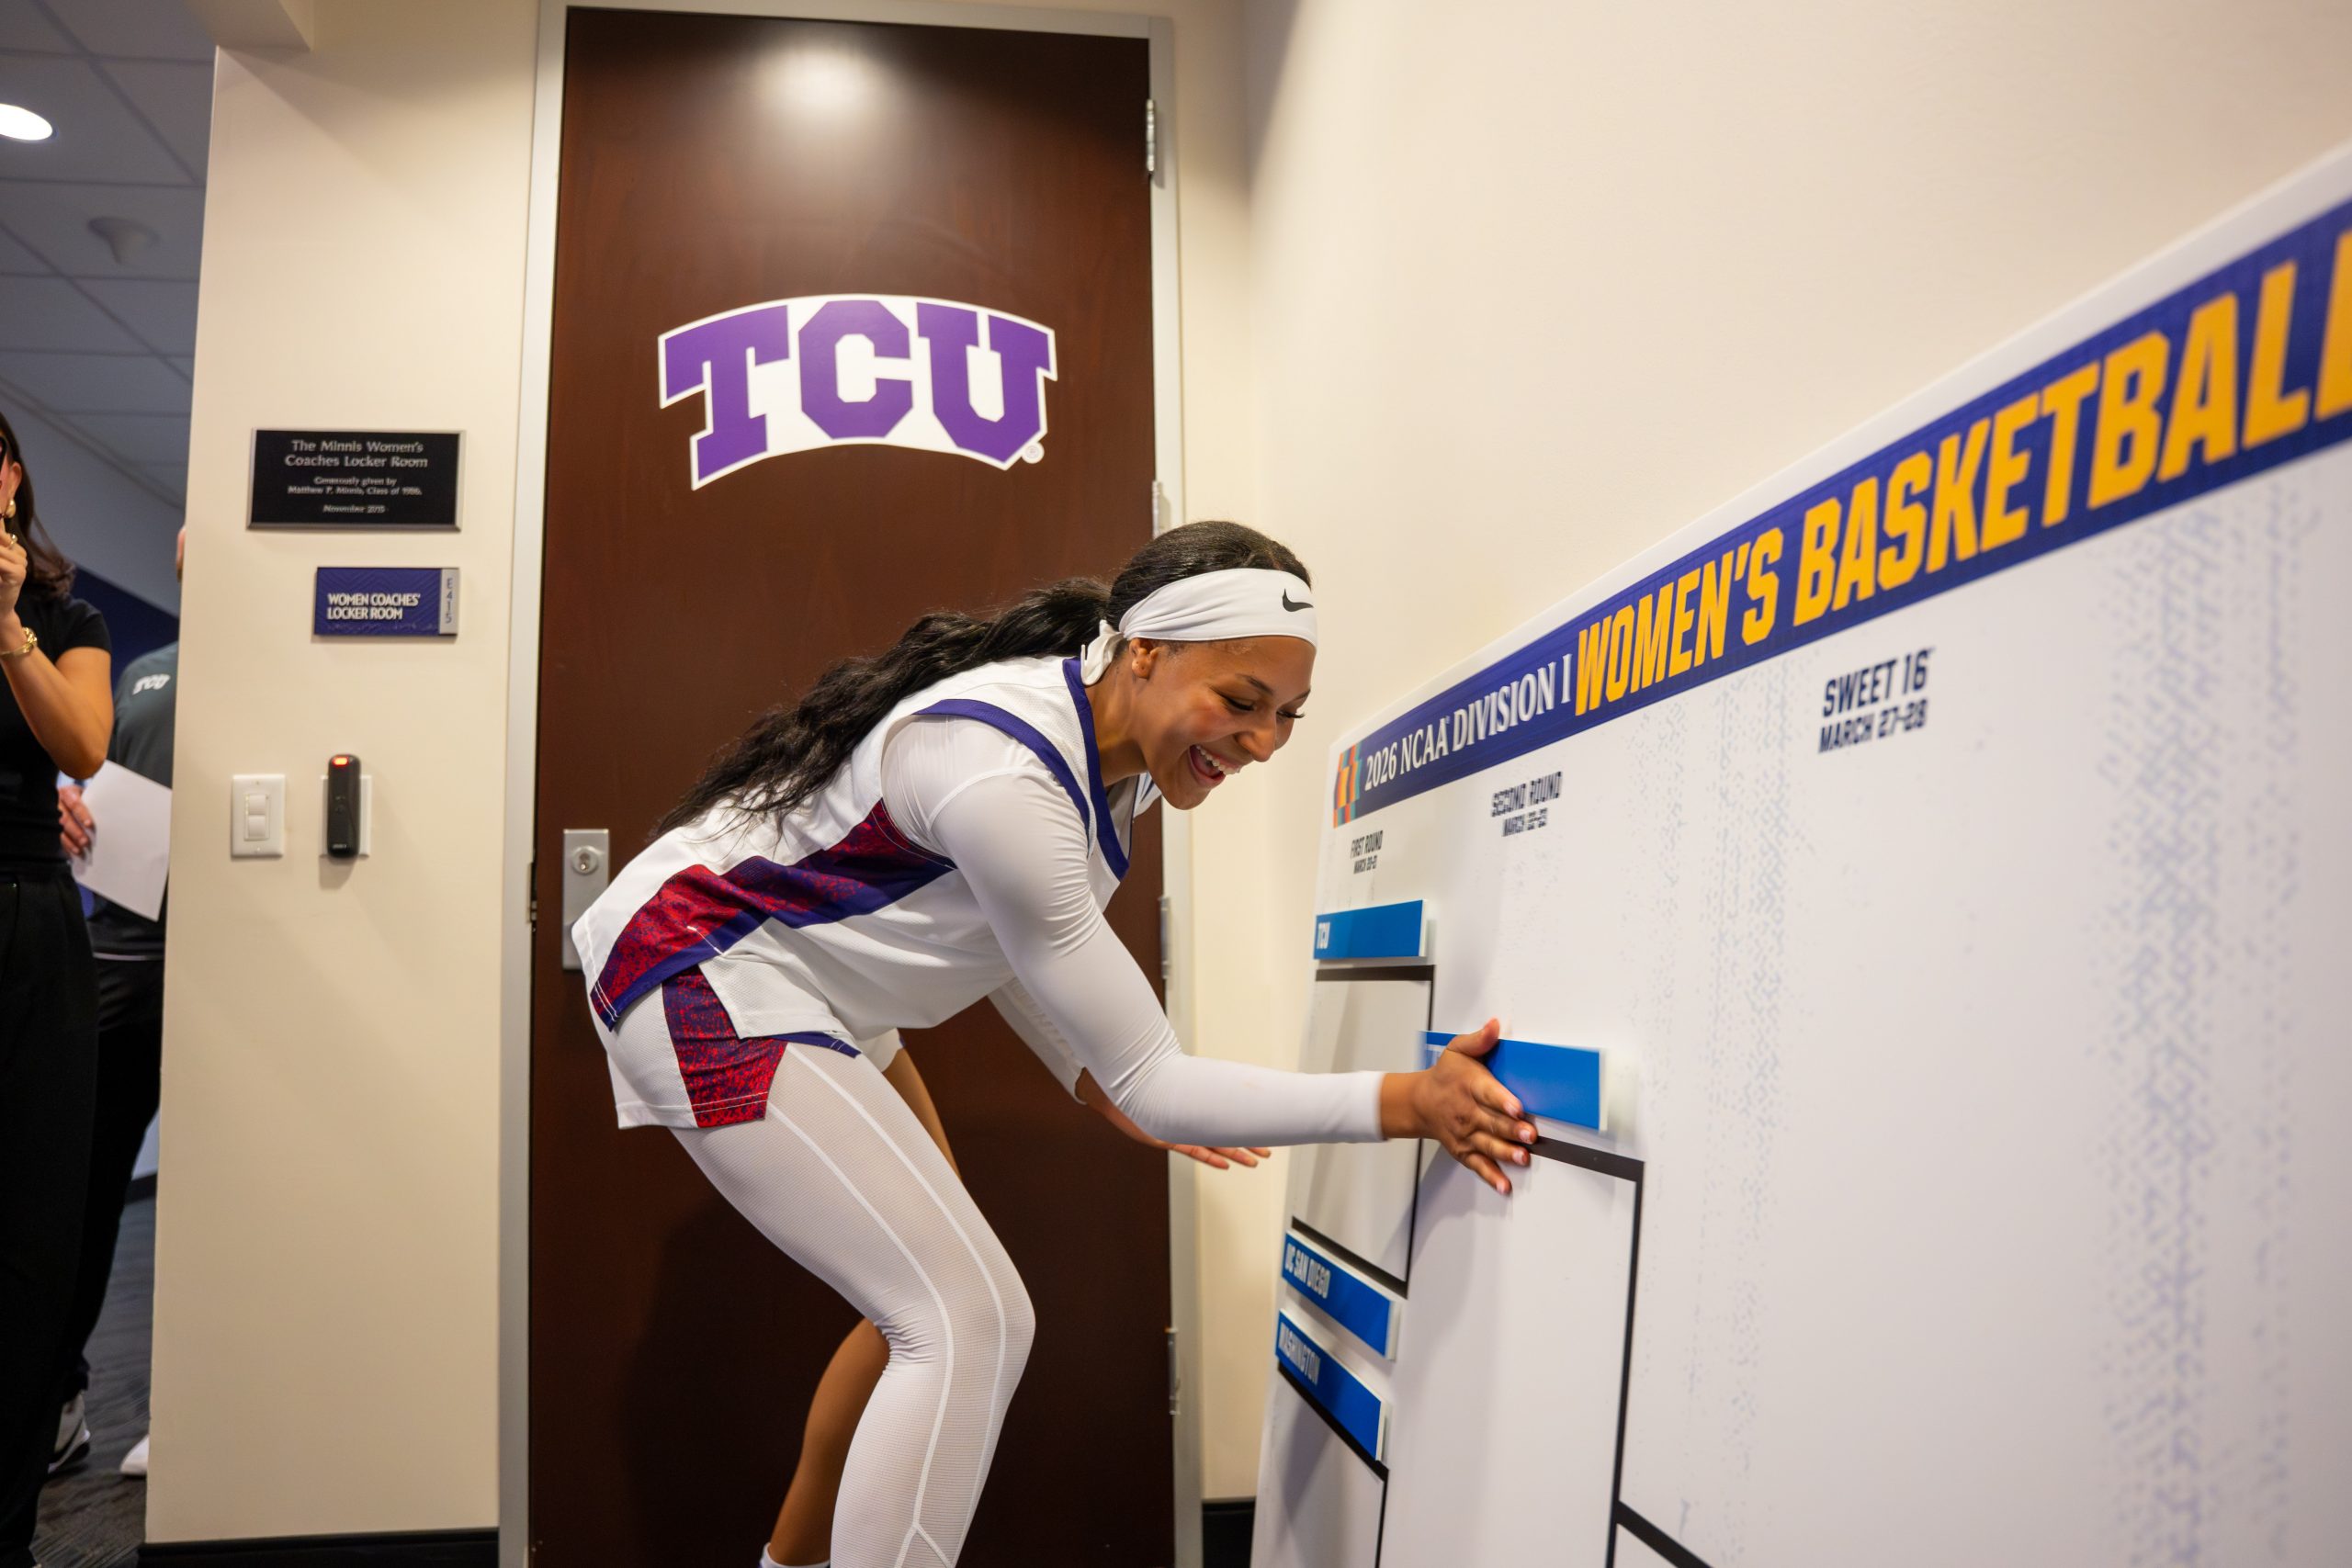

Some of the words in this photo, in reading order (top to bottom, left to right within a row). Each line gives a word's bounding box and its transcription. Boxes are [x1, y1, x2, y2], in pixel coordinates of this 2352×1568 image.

[662, 298, 1053, 483] TCU
[292, 440, 316, 452] The
[321, 441, 362, 452] Minnis
[367, 441, 424, 453] Women's
[285, 455, 340, 467] Coaches
[344, 456, 387, 468] Locker
[390, 457, 428, 468] Room
[287, 486, 323, 494] Matthew
[367, 487, 389, 495] Class
[390, 487, 401, 495] of
[313, 476, 360, 487] Generously
[361, 478, 385, 487] given
[387, 478, 398, 487] by
[322, 504, 366, 513] November
[327, 592, 369, 606] WOMEN
[370, 592, 422, 606] COACHES'
[327, 606, 368, 620] LOCKER
[369, 607, 403, 620] ROOM
[1364, 740, 1399, 792] 2026
[1400, 716, 1448, 775] NCAA
[1453, 660, 1557, 752] DIVISION
[1561, 653, 1572, 705] I
[1575, 527, 1784, 716] WOMEN'S
[1823, 658, 1898, 718] SWEET
[1903, 649, 1929, 695] 16
[1818, 713, 1875, 754] MARCH
[1878, 698, 1928, 739] 27-28
[1491, 783, 1526, 818] SECOND
[1528, 771, 1563, 807] ROUND
[1502, 814, 1525, 838] MARCH
[1350, 836, 1365, 860] FIRST
[1364, 829, 1384, 854] ROUND
[1353, 858, 1367, 874] MARCH
[1317, 921, 1330, 950] TCU
[1285, 1242, 1296, 1273] UC
[1294, 1249, 1309, 1284] SAN
[1307, 1258, 1331, 1299] DIEGO
[1278, 1322, 1321, 1386] WASHINGTON
